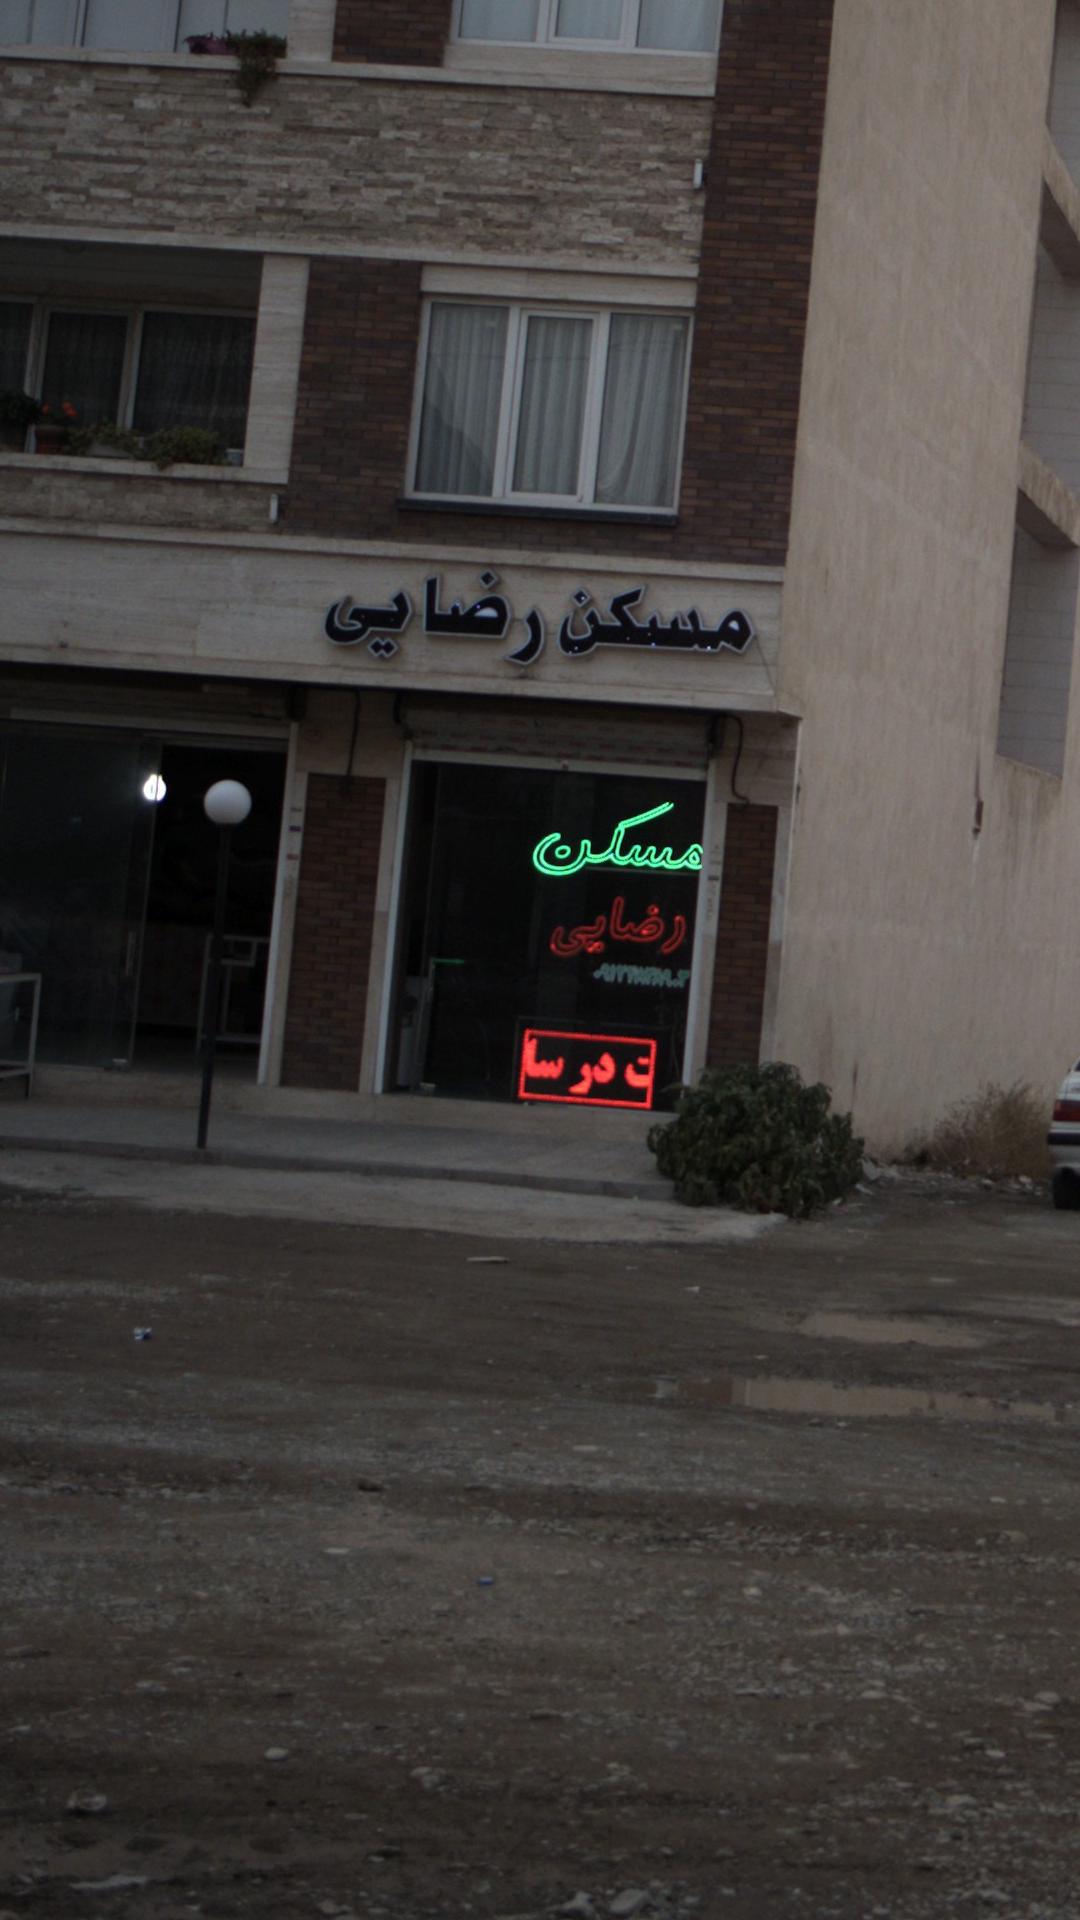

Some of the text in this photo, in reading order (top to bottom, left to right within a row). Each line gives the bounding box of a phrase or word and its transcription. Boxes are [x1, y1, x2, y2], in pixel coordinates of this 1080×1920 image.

[323, 569, 757, 665] مسکن رضایی
[532, 802, 704, 876] مسکن
[549, 896, 687, 957] رضایی
